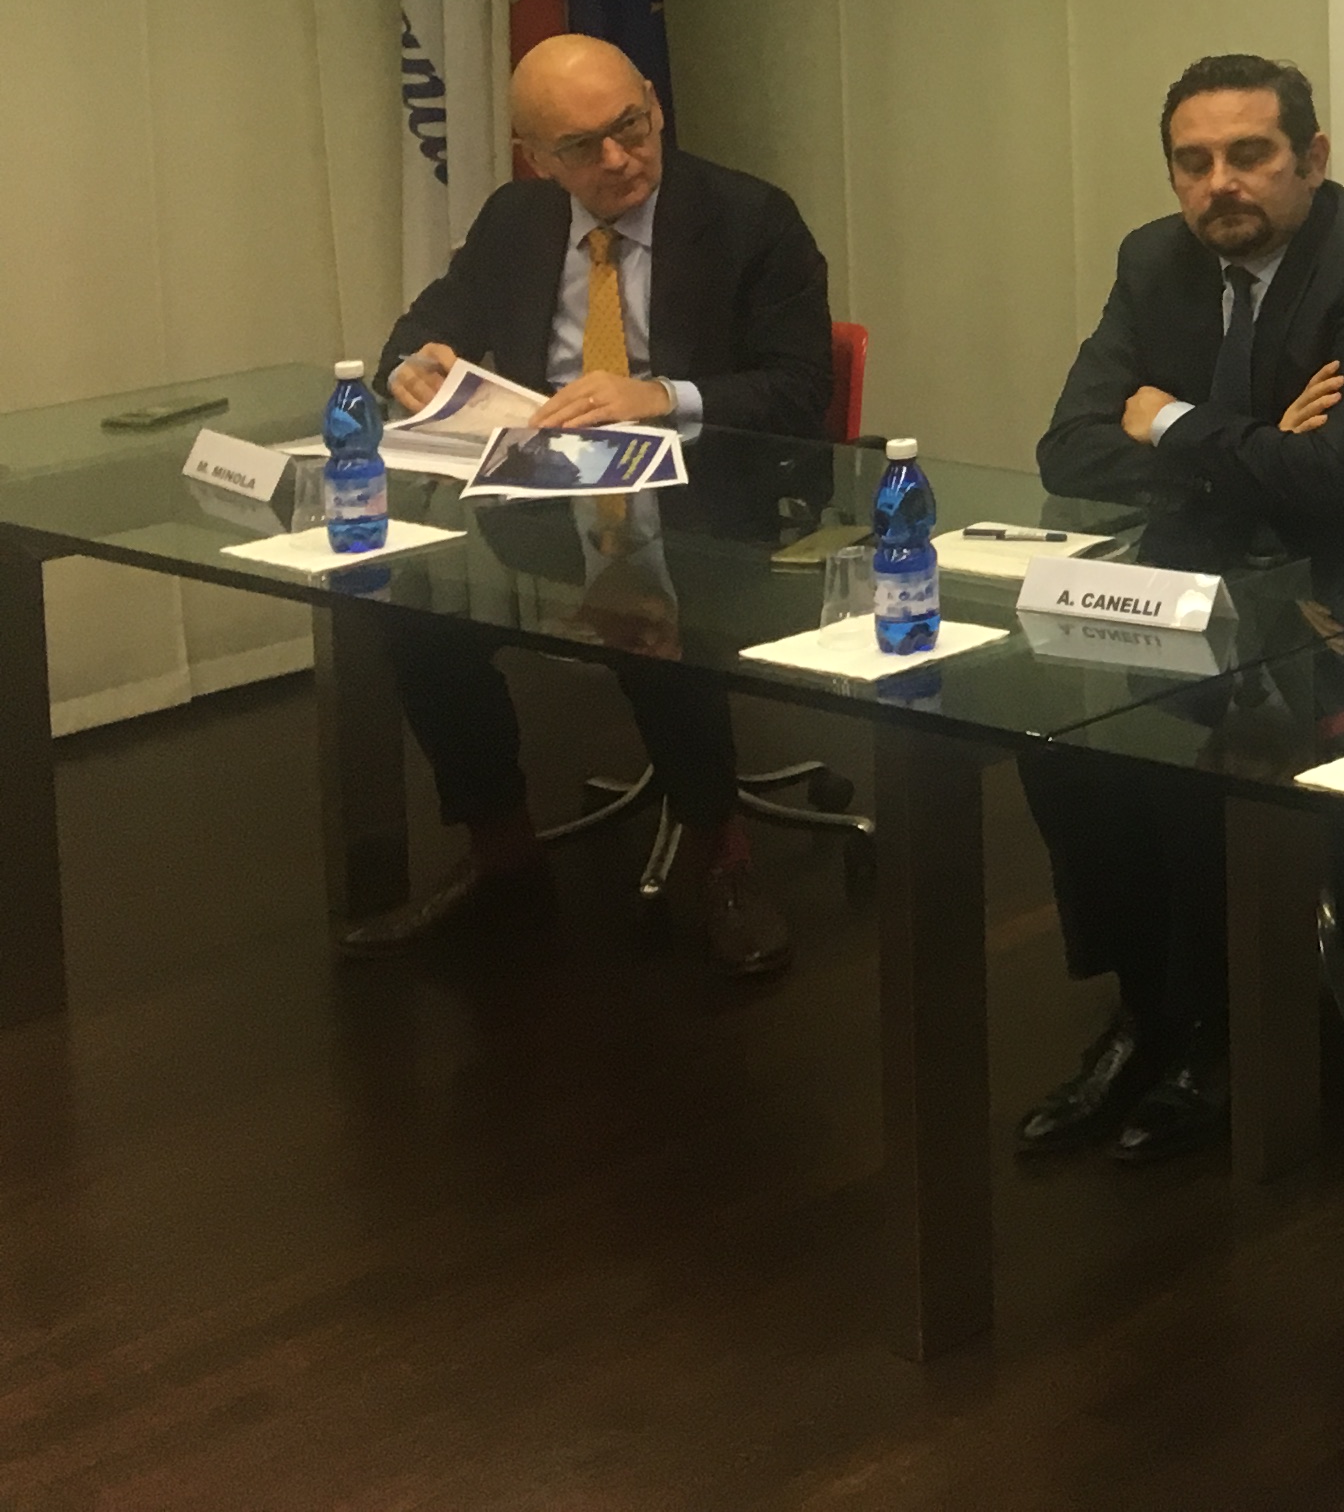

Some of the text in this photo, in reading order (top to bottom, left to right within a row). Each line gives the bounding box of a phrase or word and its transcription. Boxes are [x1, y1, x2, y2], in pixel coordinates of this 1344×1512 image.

[211, 466, 256, 490] MINOLA
[1056, 590, 1162, 617] A. CANELLI
